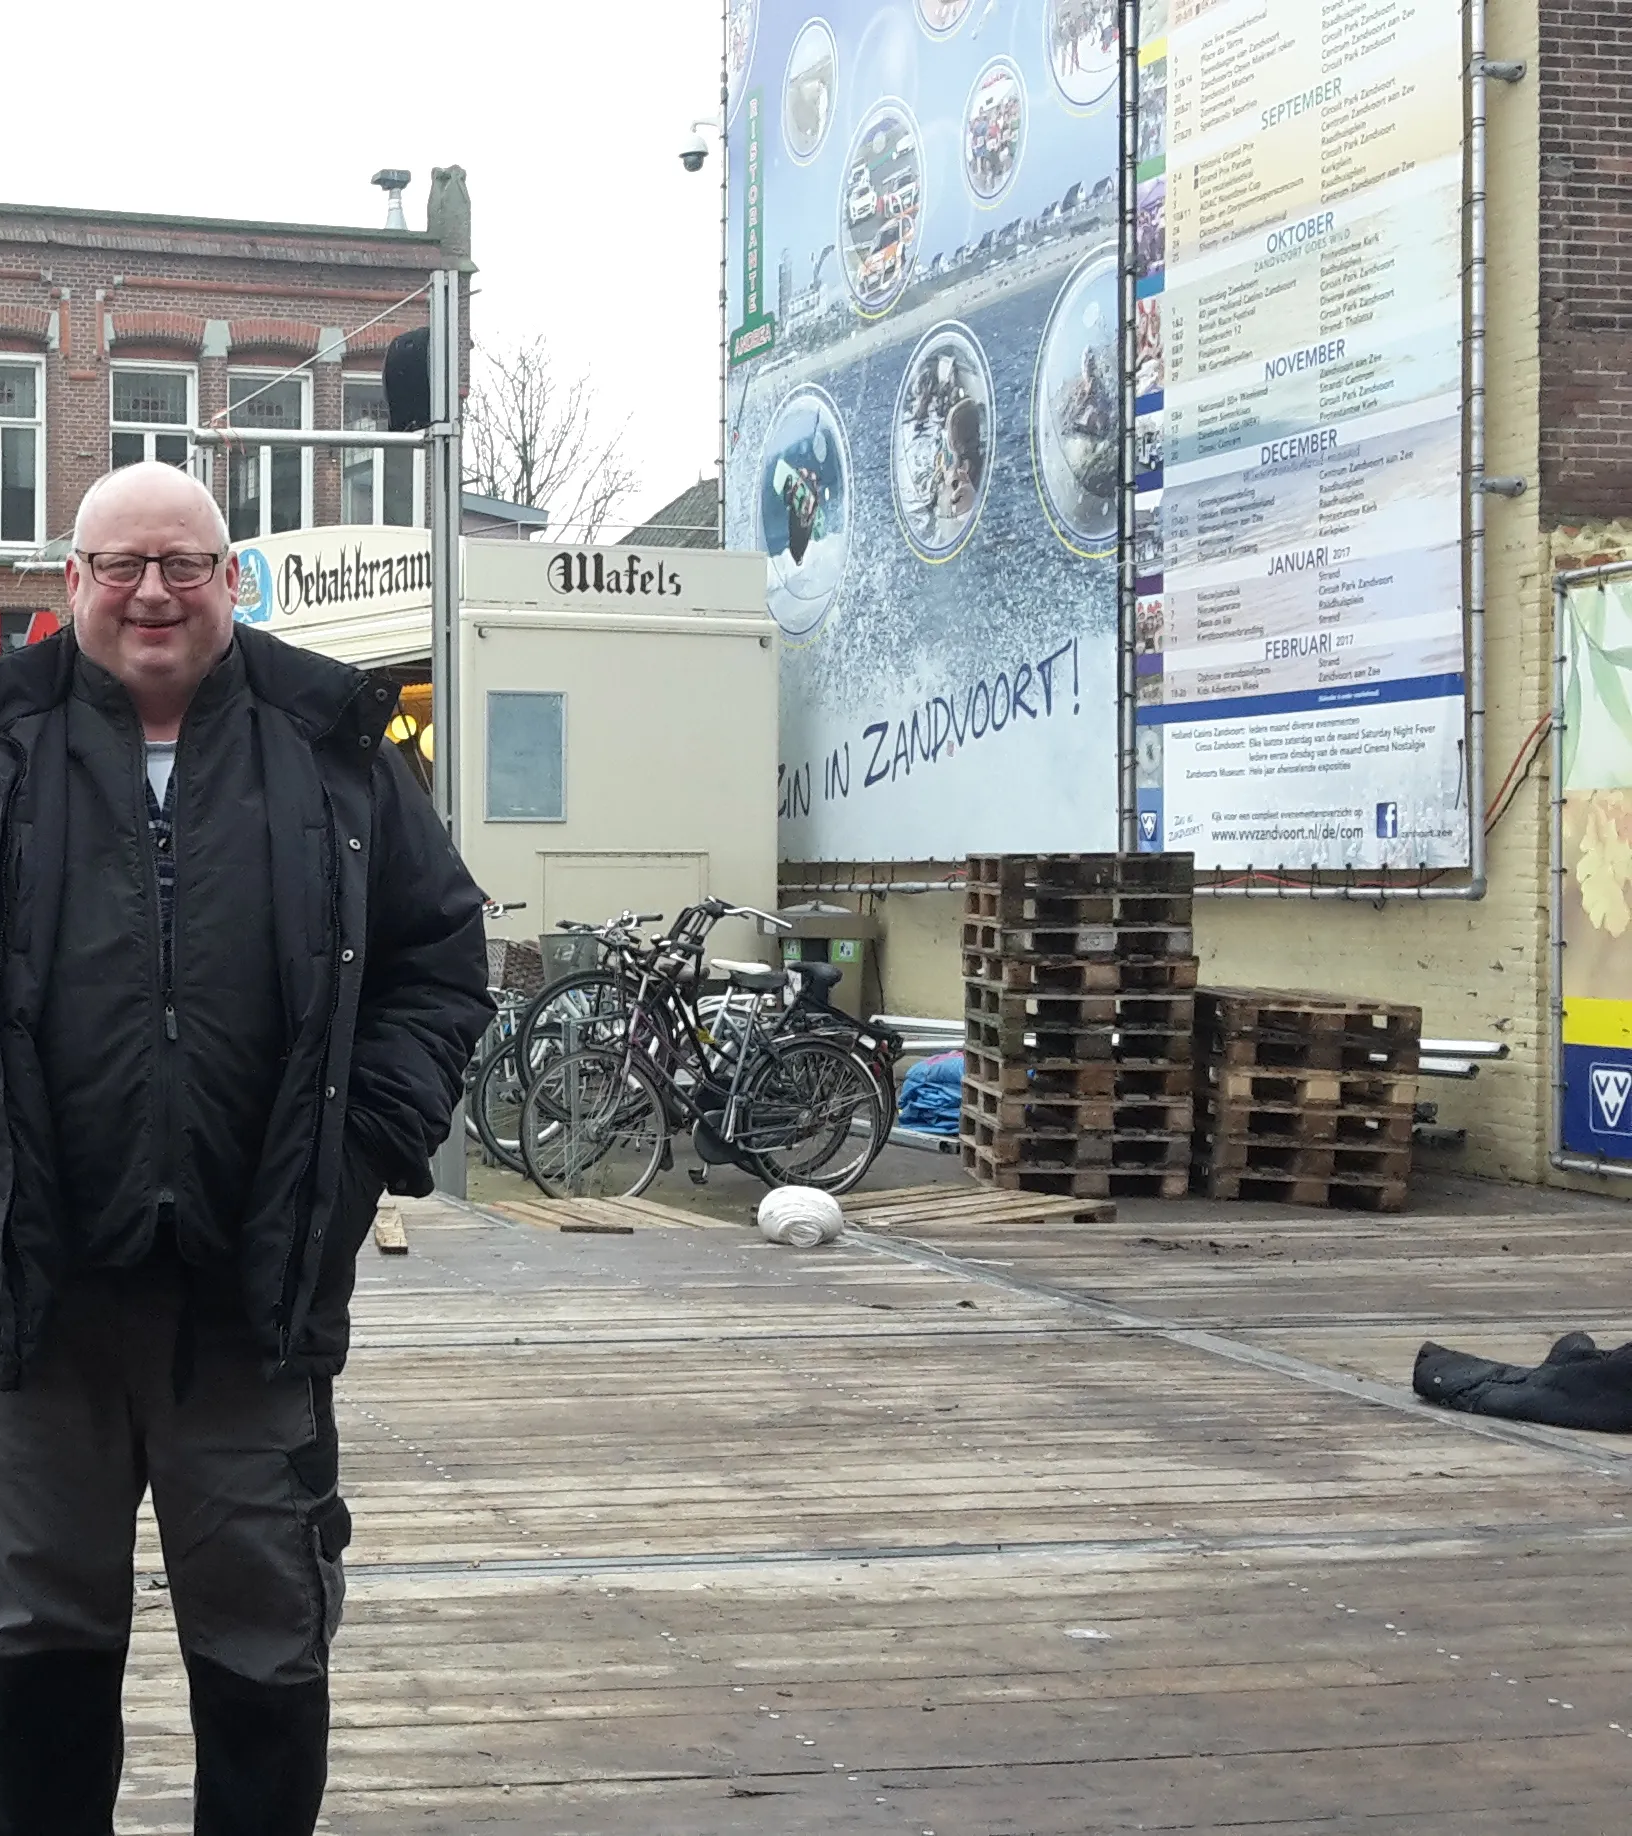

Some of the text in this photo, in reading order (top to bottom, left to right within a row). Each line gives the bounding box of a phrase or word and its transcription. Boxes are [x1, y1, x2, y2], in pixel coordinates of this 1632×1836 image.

[1322, 28, 1343, 45] Circuit
[1345, 20, 1359, 32] Park
[1361, 2, 1396, 26] Zandvoort
[1322, 8, 1416, 59] Centrum Zandvoort aan Zee
[1322, 32, 1396, 73] Circuit Park Zandvoort
[1261, 77, 1342, 131] SEPTEMBER
[1321, 77, 1396, 117] Circuit Park Zandvoort
[1321, 114, 1350, 132] Centrum
[1351, 97, 1386, 119] Zandvoort
[1388, 91, 1400, 102] aan
[1321, 122, 1396, 160] Circuit Park Zandvoort
[1351, 171, 1386, 192] Zandvoort
[747, 97, 758, 314] RISTORANTE
[1266, 211, 1335, 254] OKTOBER
[1360, 259, 1395, 278] Zandvoort
[1343, 302, 1358, 313] Park
[1360, 288, 1395, 308] Zandvoort
[1265, 339, 1345, 381] NOVEMBER
[1342, 390, 1357, 401] Park
[1359, 379, 1395, 396] Zandvoort
[1261, 429, 1338, 466] DECEMBER
[1349, 457, 1384, 473] Zandvoort
[547, 551, 682, 597] Wafels
[1268, 546, 1328, 576] JANUARI
[1333, 546, 1351, 560] 2017
[1341, 581, 1356, 592] Park
[1358, 575, 1394, 589] Zandvoort
[1265, 632, 1354, 661] FEBRUARI 2017
[1318, 666, 1381, 682] Zandvoort aan Zee
[824, 741, 850, 800] IN
[862, 637, 1080, 788] ZANDVOORT!
[1361, 728, 1391, 739] Saturday
[1393, 725, 1413, 738] Night
[1415, 724, 1436, 734] Fever
[1364, 742, 1390, 753] Cinema
